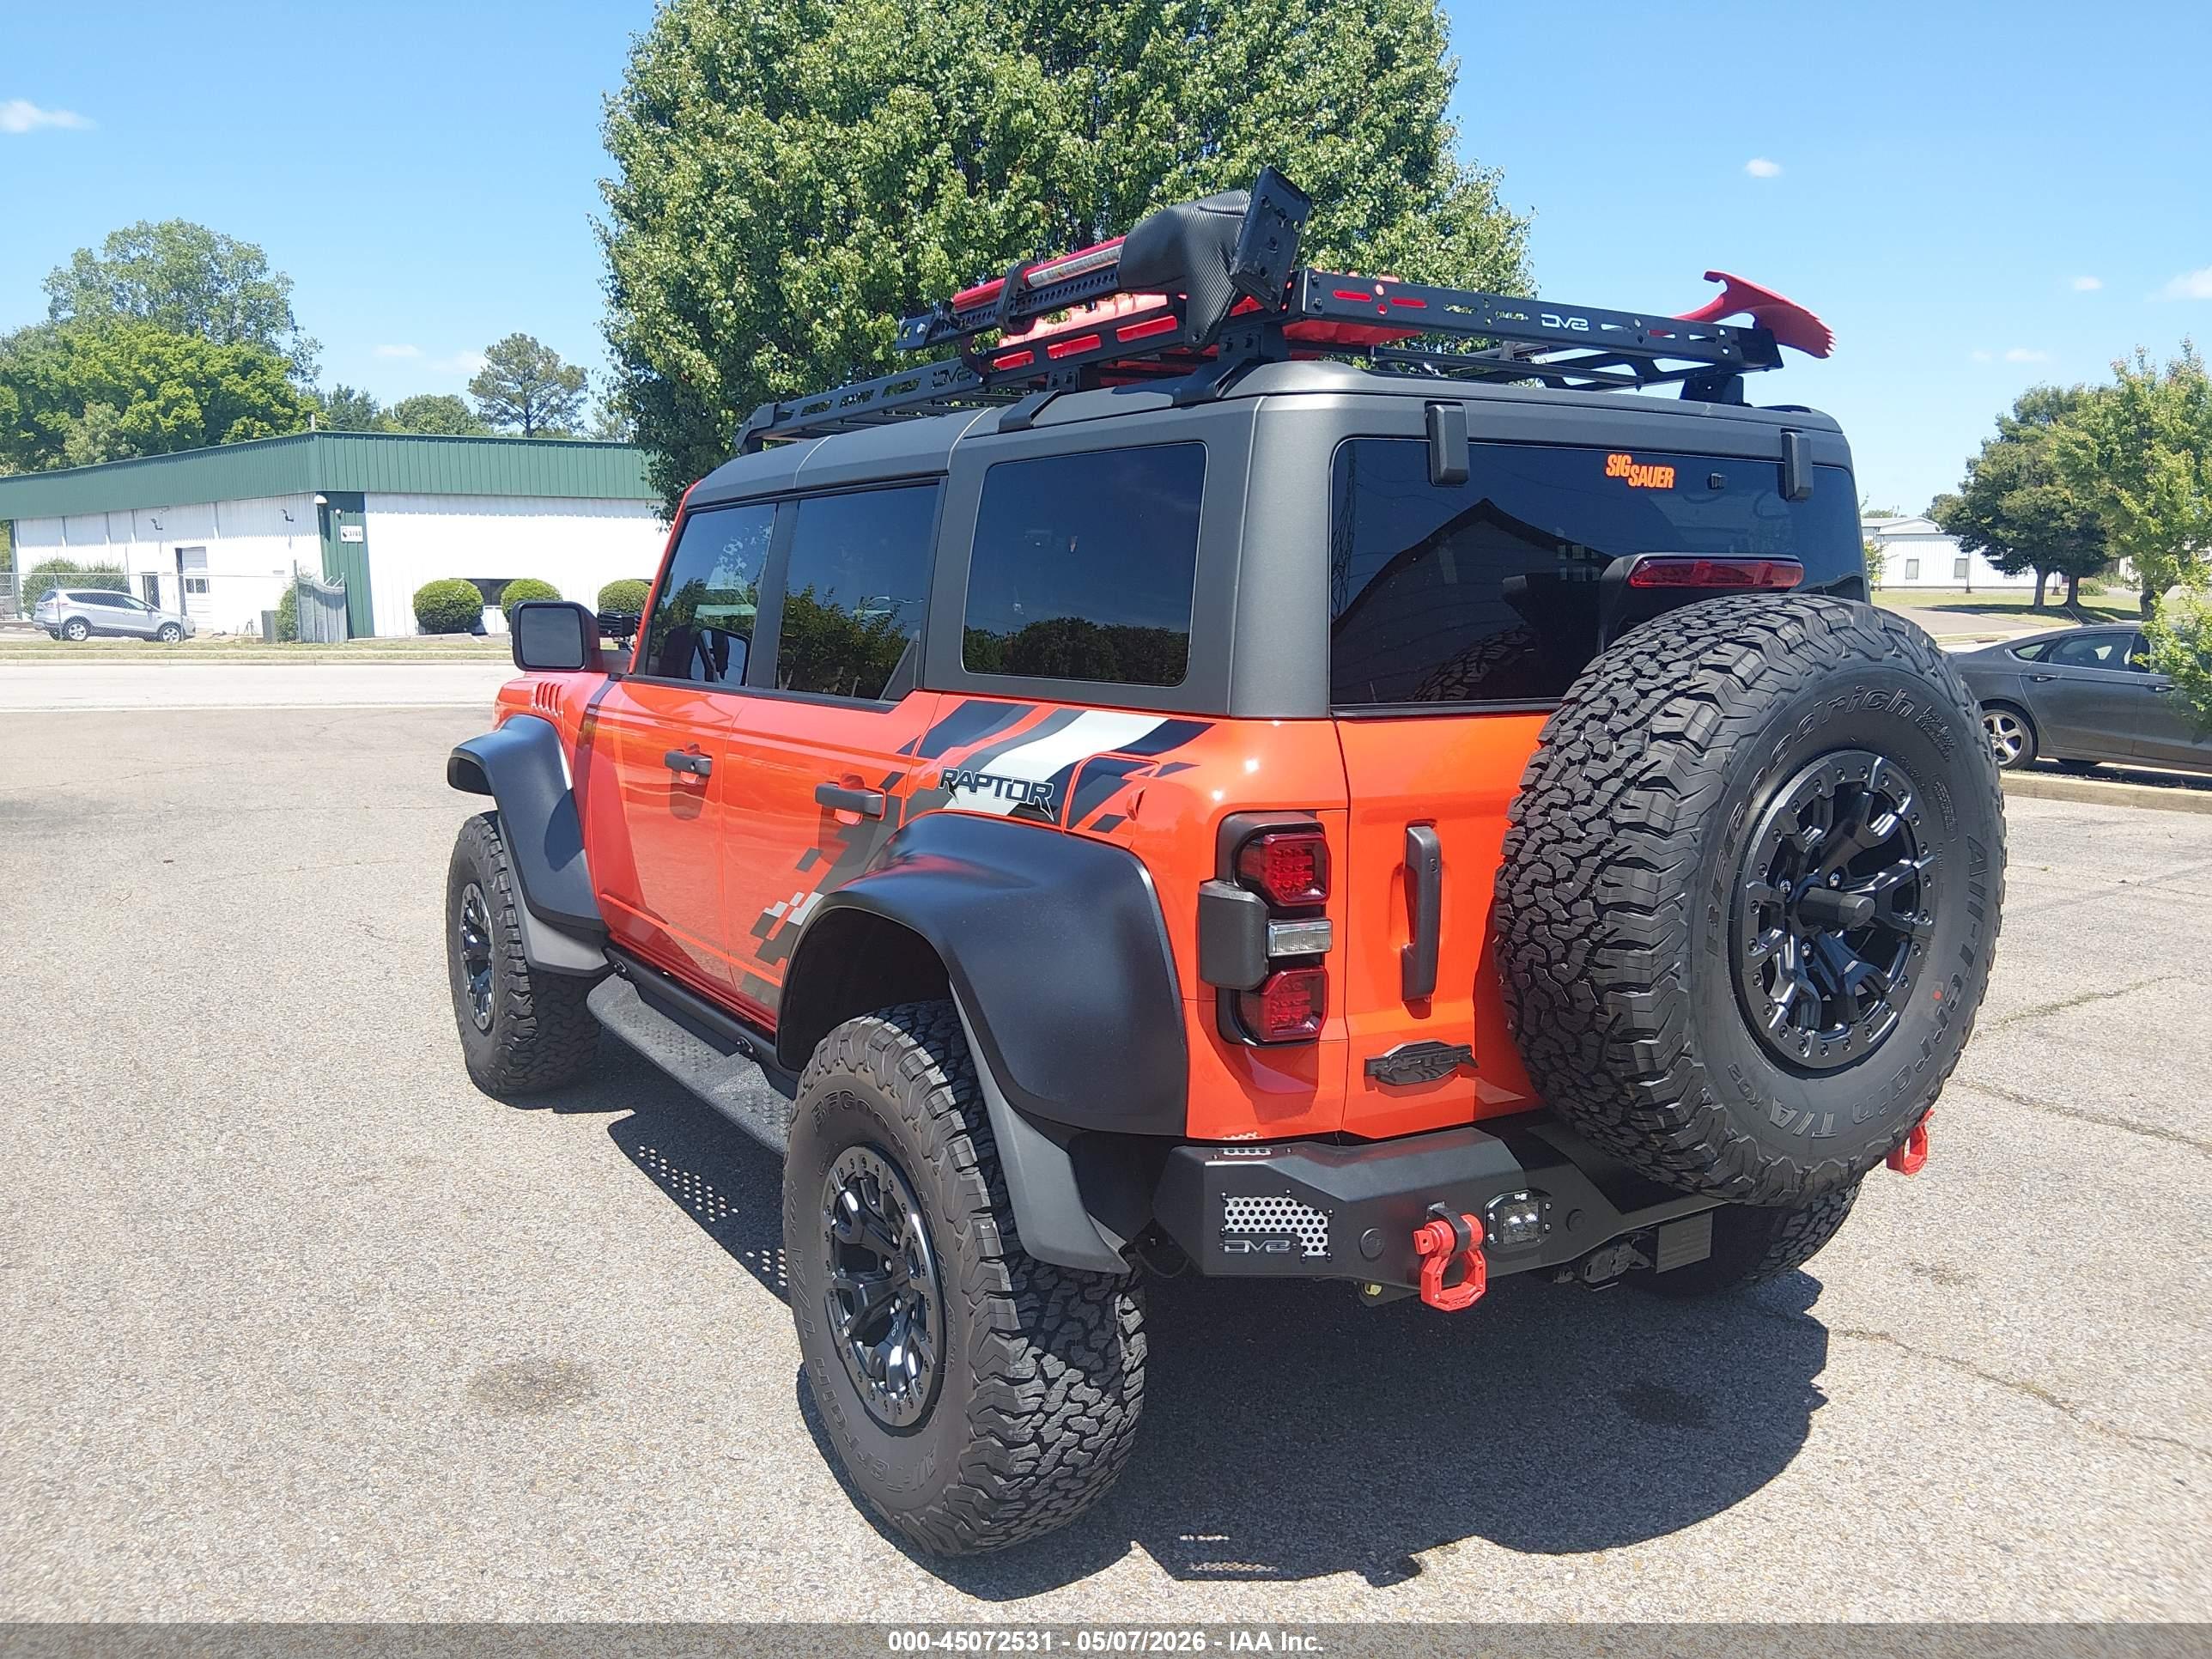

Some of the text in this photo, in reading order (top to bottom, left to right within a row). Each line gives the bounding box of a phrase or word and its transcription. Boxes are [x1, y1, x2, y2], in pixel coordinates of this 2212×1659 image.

[1606, 453, 1674, 489] SIG SAUER
[939, 768, 1054, 822] RAPTOR
[1769, 1096, 1838, 1139] T/A
